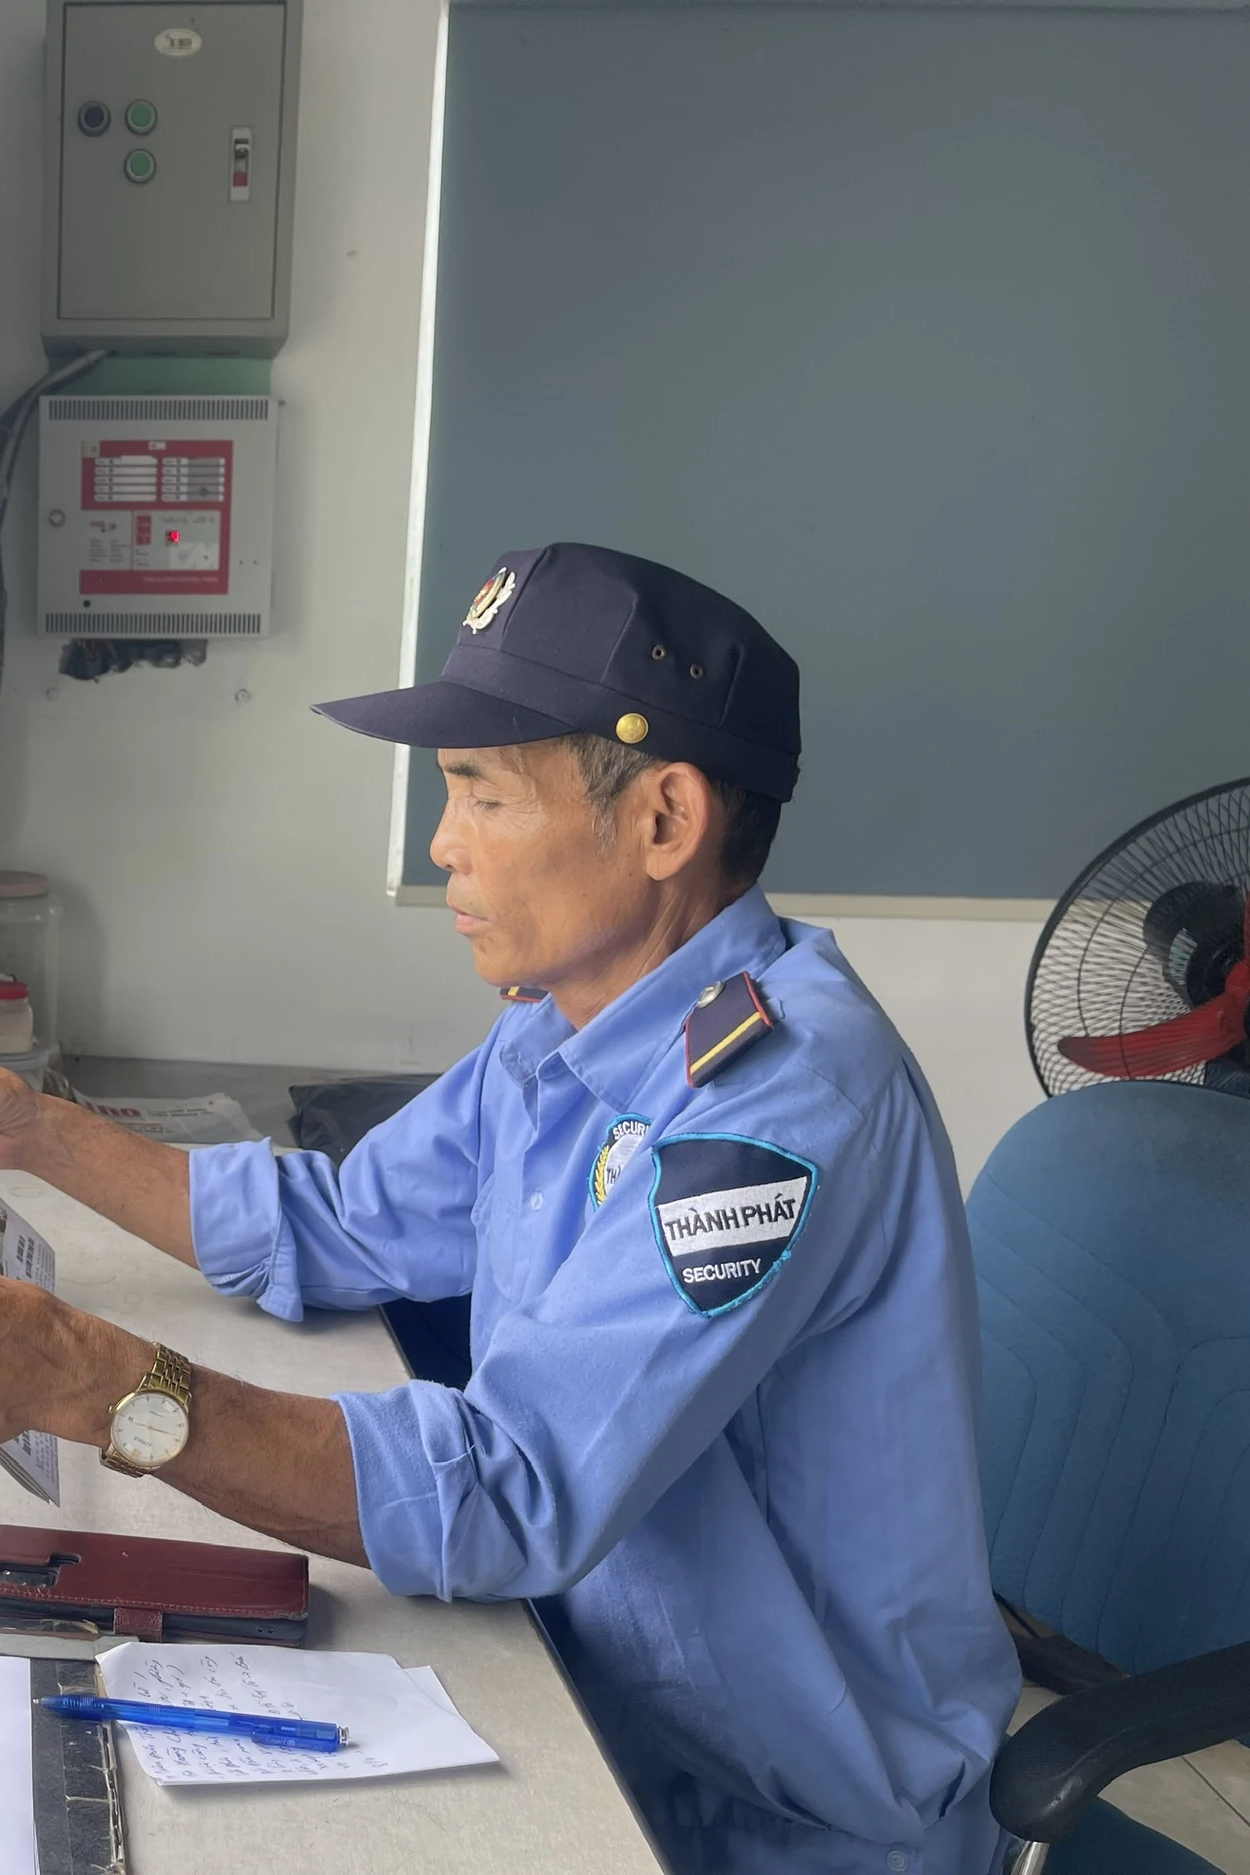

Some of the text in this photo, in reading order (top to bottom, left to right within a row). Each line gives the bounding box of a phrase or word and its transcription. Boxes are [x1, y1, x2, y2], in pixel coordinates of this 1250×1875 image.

[664, 1193, 797, 1241] THÀNH PHÁT
[682, 1258, 763, 1284] SECURITY
